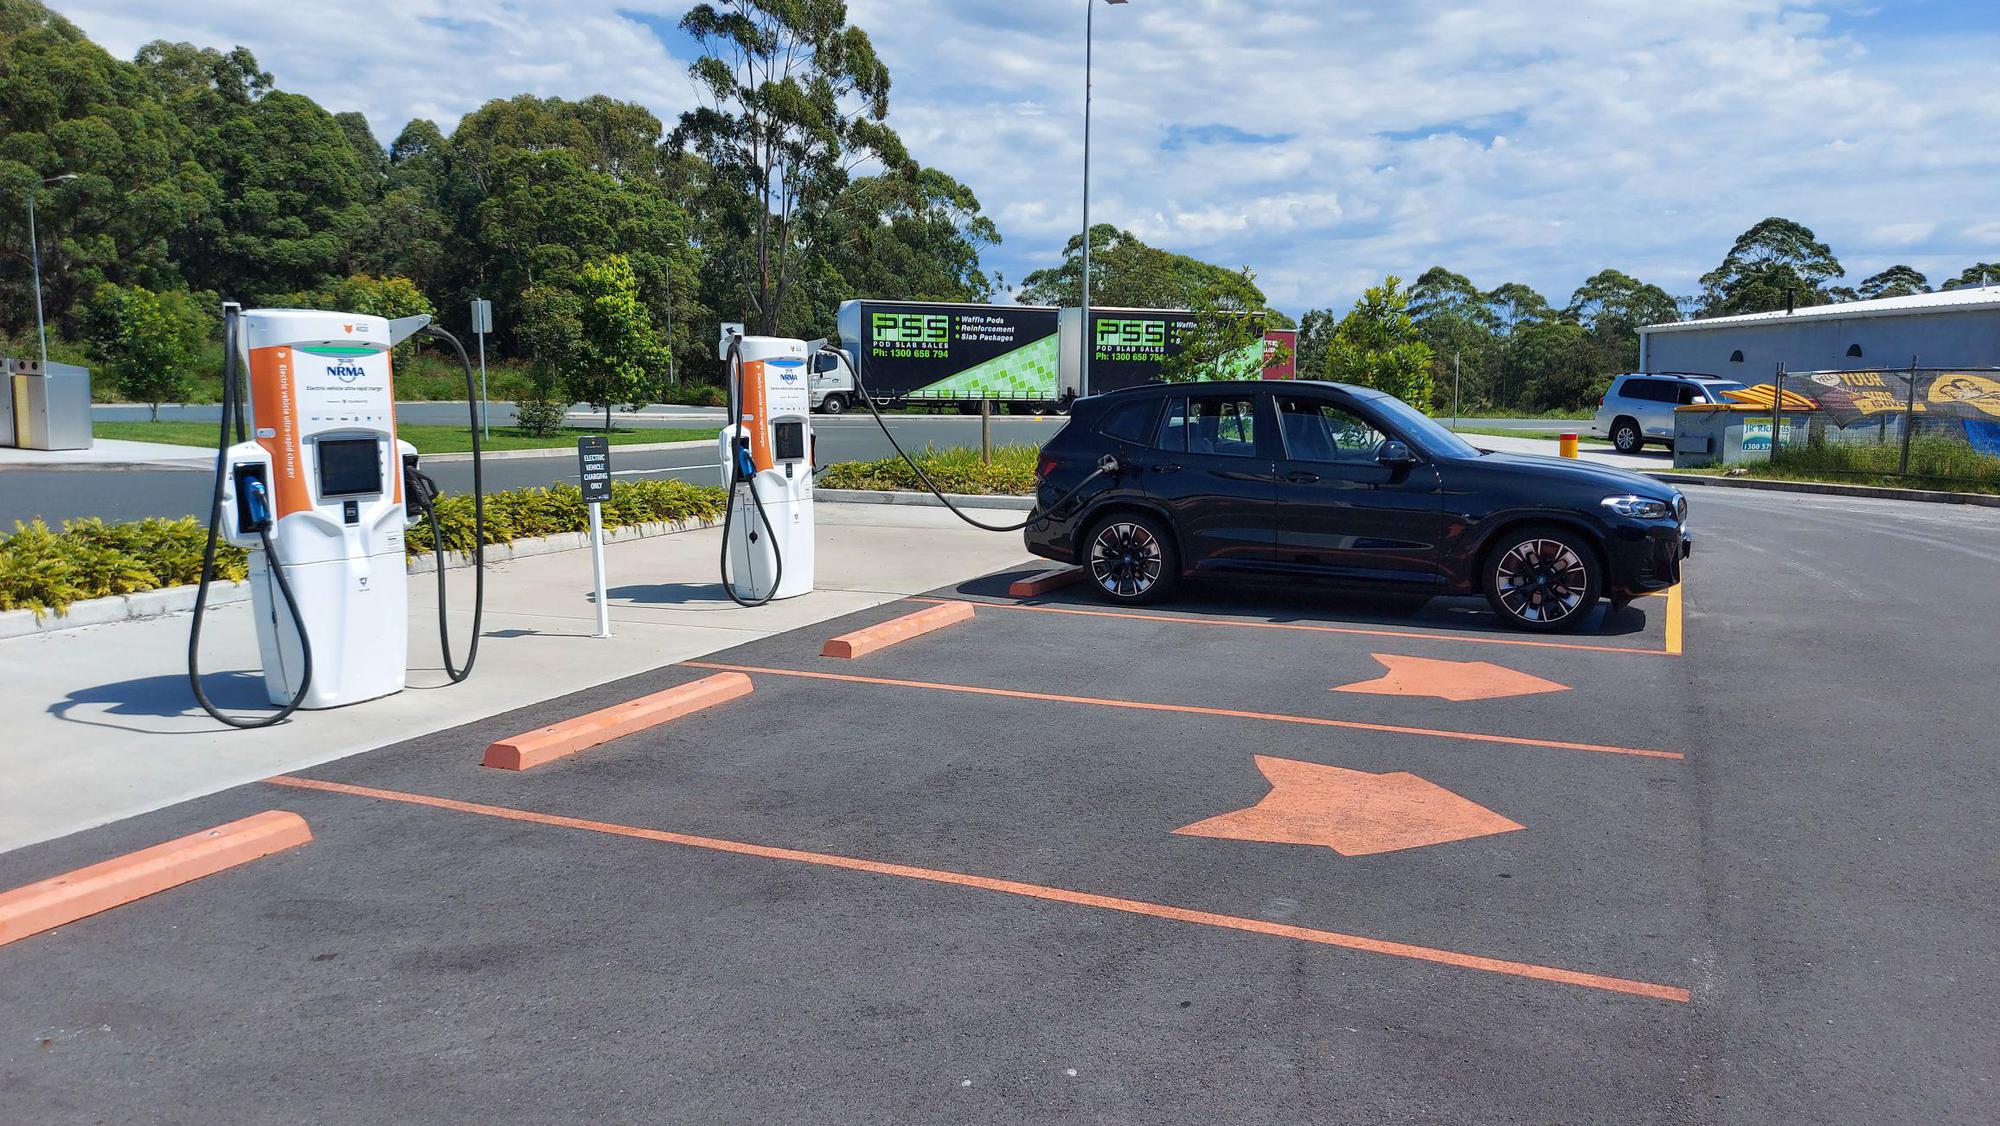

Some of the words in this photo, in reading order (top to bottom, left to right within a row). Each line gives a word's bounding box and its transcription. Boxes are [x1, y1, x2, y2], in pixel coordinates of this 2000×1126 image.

[874, 315, 948, 340] PSS
[961, 325, 1015, 333] Reinforcement
[1097, 320, 1165, 345] PSS
[961, 333, 978, 341] Slab
[979, 334, 1014, 342] Packages
[873, 348, 888, 357] Ph:
[890, 349, 911, 357] 1300
[914, 349, 930, 358] 658
[933, 350, 949, 358] 794
[1095, 352, 1109, 361] Ph:
[1111, 352, 1131, 361] 1300
[1132, 352, 1147, 361] 658
[327, 366, 366, 377] NRMA
[1840, 372, 1887, 387] YOUR
[584, 454, 606, 462] ELECTRIC
[585, 463, 605, 471] VEHICLE
[583, 472, 608, 480] CHARGING
[590, 482, 603, 490] ONLY
